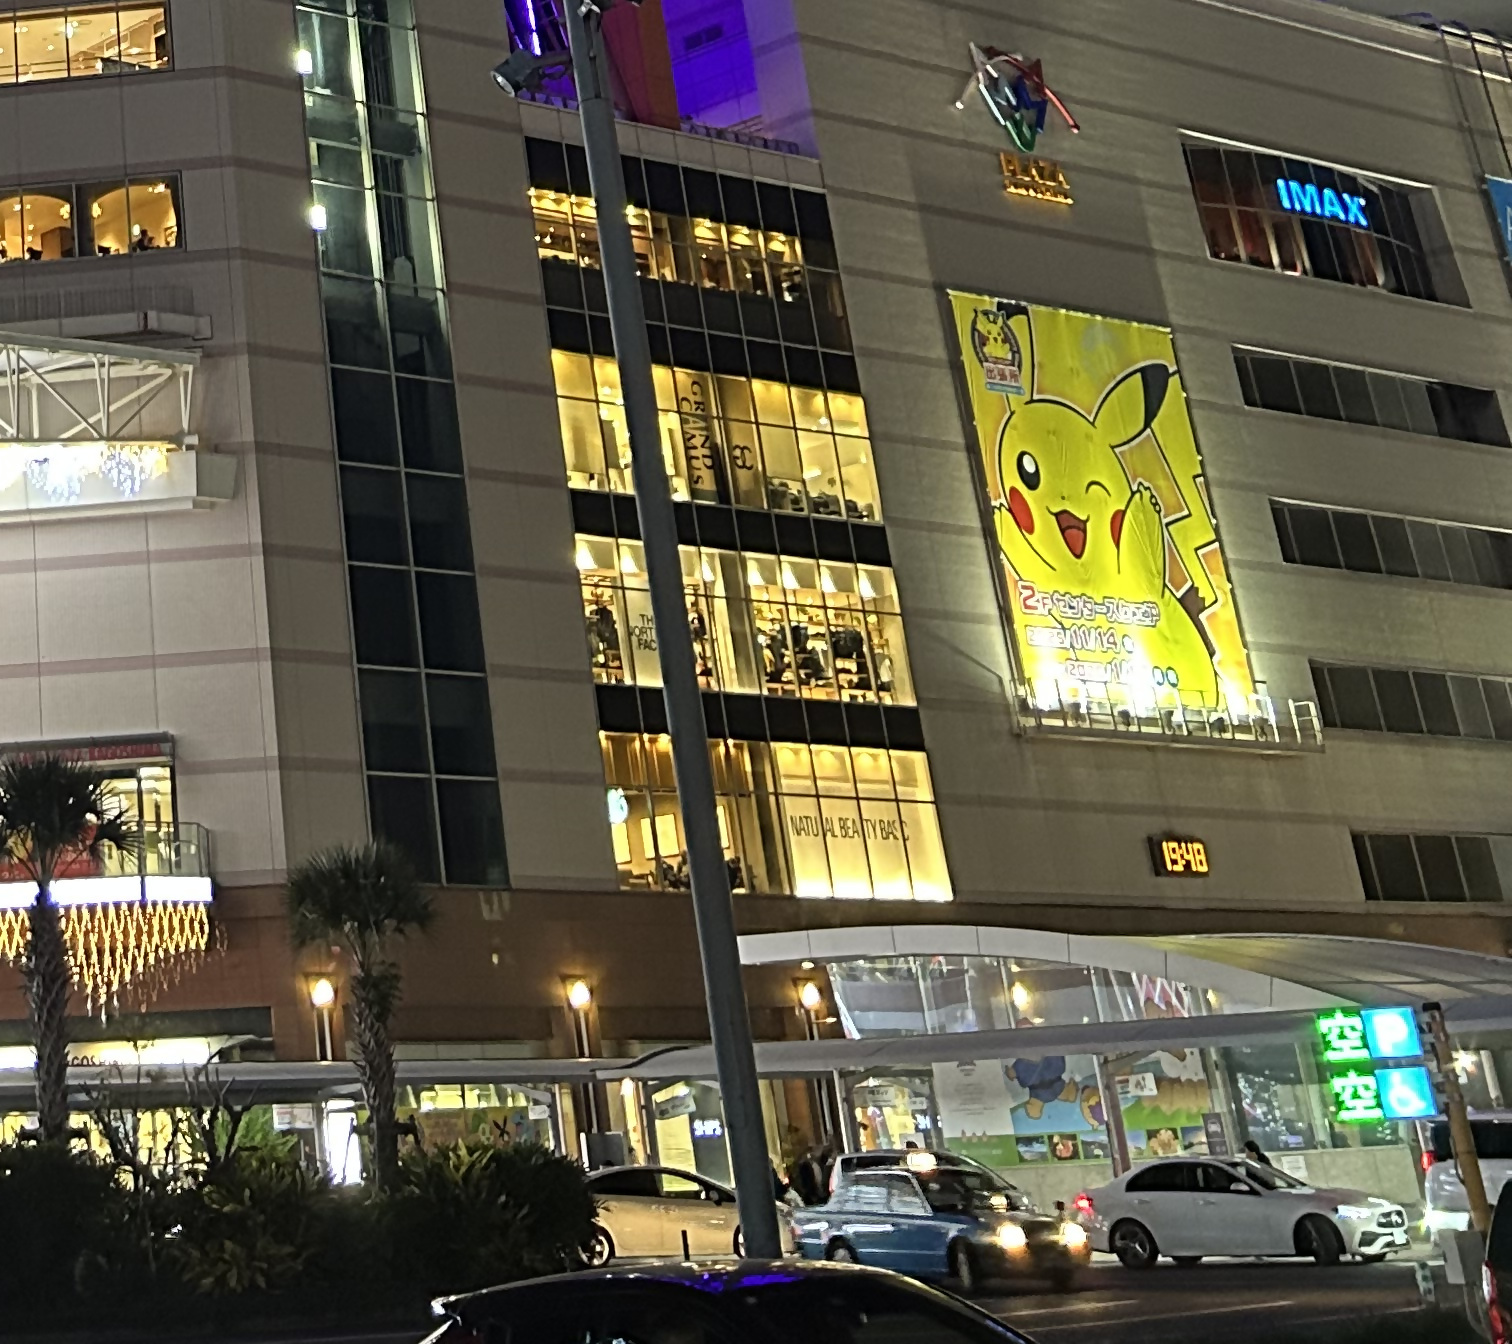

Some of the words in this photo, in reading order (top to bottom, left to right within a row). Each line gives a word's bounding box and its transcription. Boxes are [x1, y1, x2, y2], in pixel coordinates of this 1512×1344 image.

[1276, 178, 1368, 227] IMAX
[681, 396, 706, 486] CAMUS
[691, 380, 714, 470] GRAND
[630, 626, 654, 639] ORT
[639, 613, 654, 625] TH
[638, 638, 657, 651] FAC
[790, 815, 839, 838] NATUAL
[838, 817, 878, 840] BEATY
[878, 819, 910, 841] BASC
[1162, 841, 1208, 872] 19:48
[1318, 1009, 1370, 1061] 空
[1332, 1068, 1384, 1121] 空
